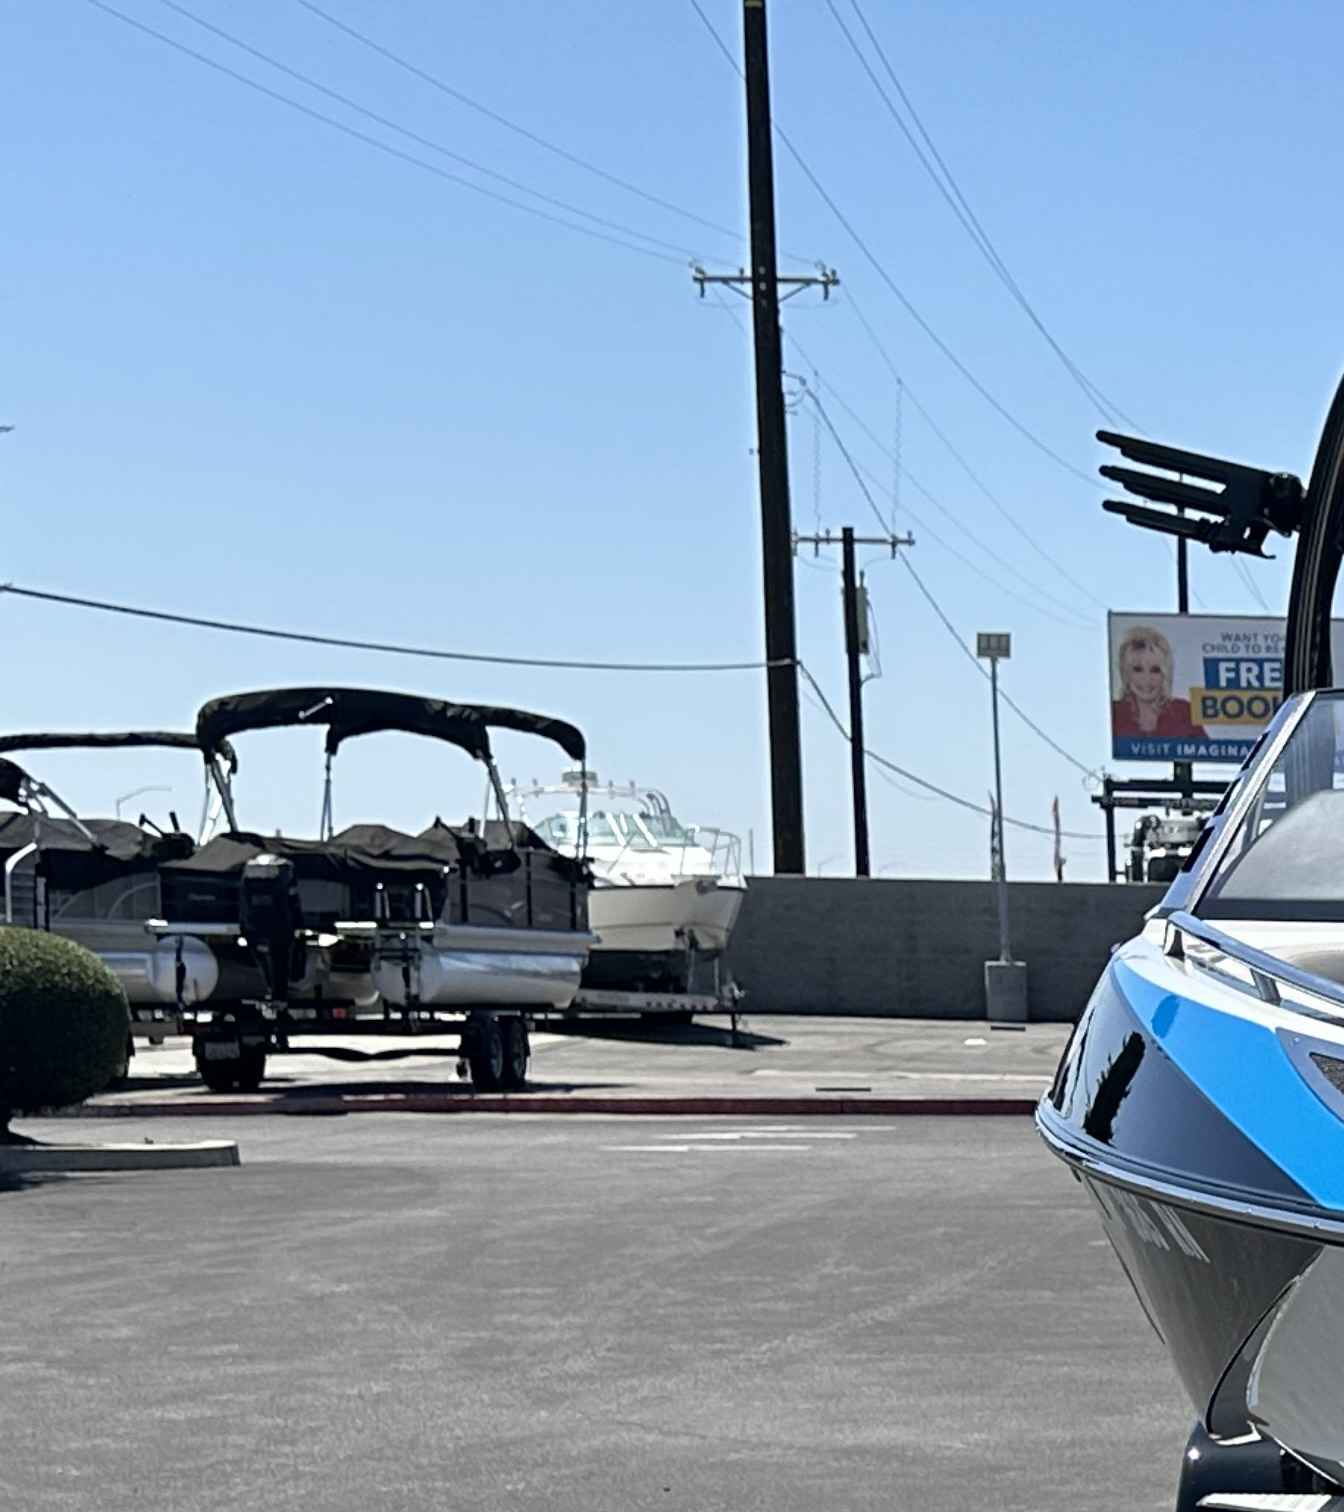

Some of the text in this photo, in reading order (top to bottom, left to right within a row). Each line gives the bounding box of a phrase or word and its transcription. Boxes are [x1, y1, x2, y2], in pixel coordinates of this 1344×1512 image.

[1220, 631, 1283, 643] WANT YO
[1201, 642, 1284, 654] CHILD TO RE
[1218, 660, 1283, 688] FRE
[1201, 694, 1279, 719] BOO
[1131, 743, 1170, 755] VISIT
[1176, 743, 1250, 757] IMAGINA
